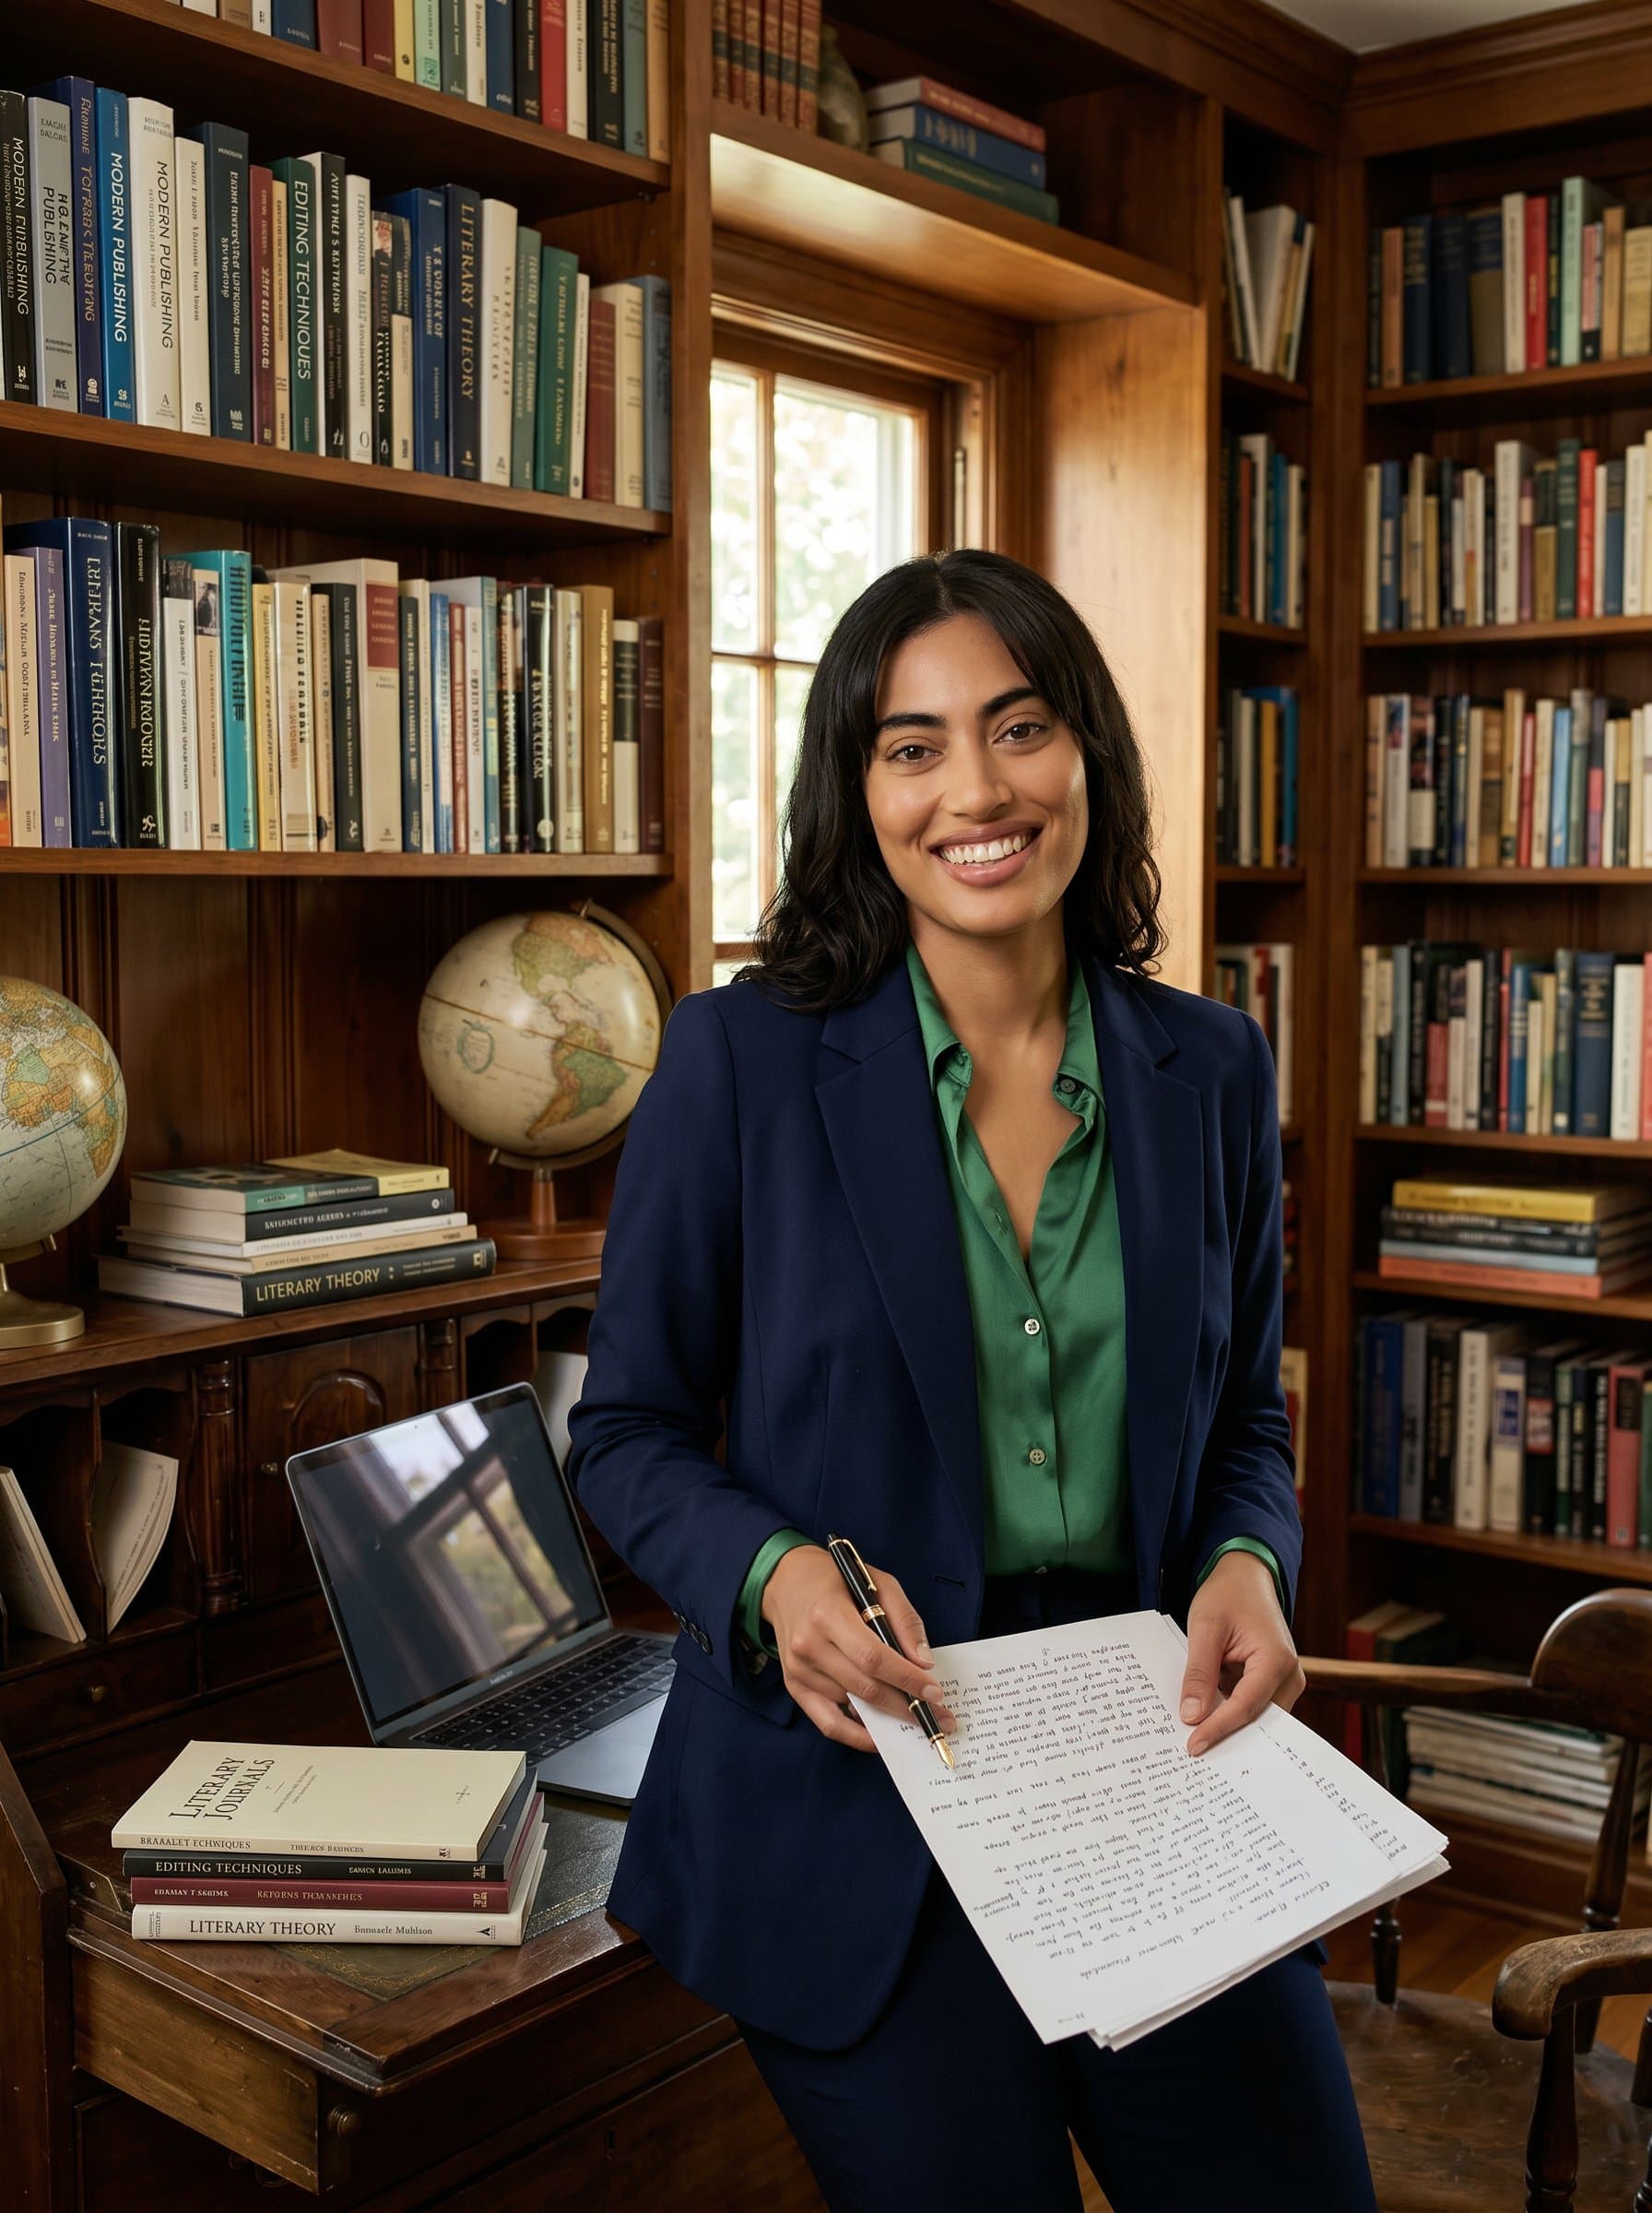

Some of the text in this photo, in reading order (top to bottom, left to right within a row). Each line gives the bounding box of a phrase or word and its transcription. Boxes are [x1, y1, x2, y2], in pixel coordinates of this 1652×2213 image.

[13, 137, 26, 208] MODERN
[111, 152, 124, 231] MODERN
[294, 181, 310, 254] EDITING
[112, 237, 127, 343] PUBLISHING
[157, 160, 173, 349] MODERN PUBLISHING
[461, 203, 475, 400] LITERARY THEORY
[256, 1268, 380, 1301] LITERARY THEORY
[168, 1757, 245, 1818] LITERARY
[155, 1862, 301, 1876] EDITING TECHNIQUES
[190, 1920, 336, 1935] LITERARY THEORY
